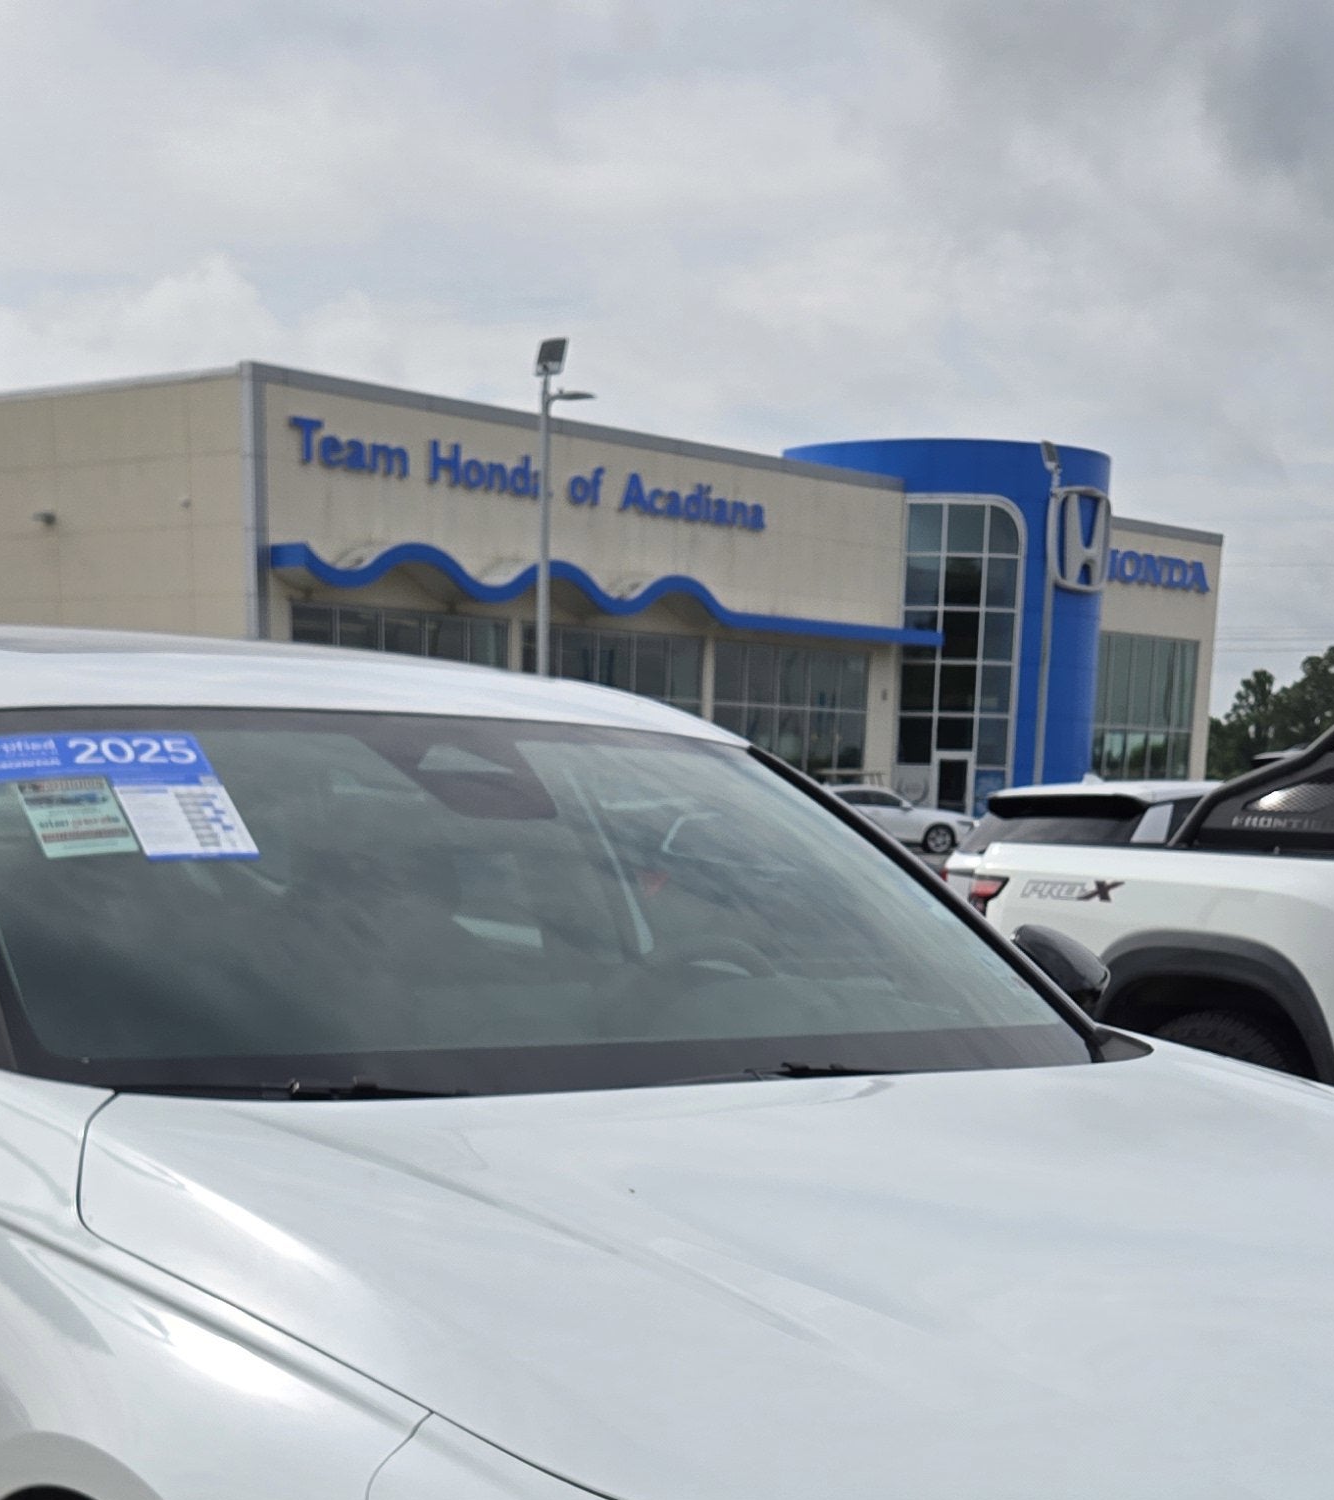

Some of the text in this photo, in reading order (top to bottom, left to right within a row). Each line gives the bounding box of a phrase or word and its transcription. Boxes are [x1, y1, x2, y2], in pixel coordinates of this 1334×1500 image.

[289, 416, 409, 479] Team
[569, 466, 605, 507] of
[619, 472, 765, 532] Acadiana
[68, 737, 197, 764] 2025
